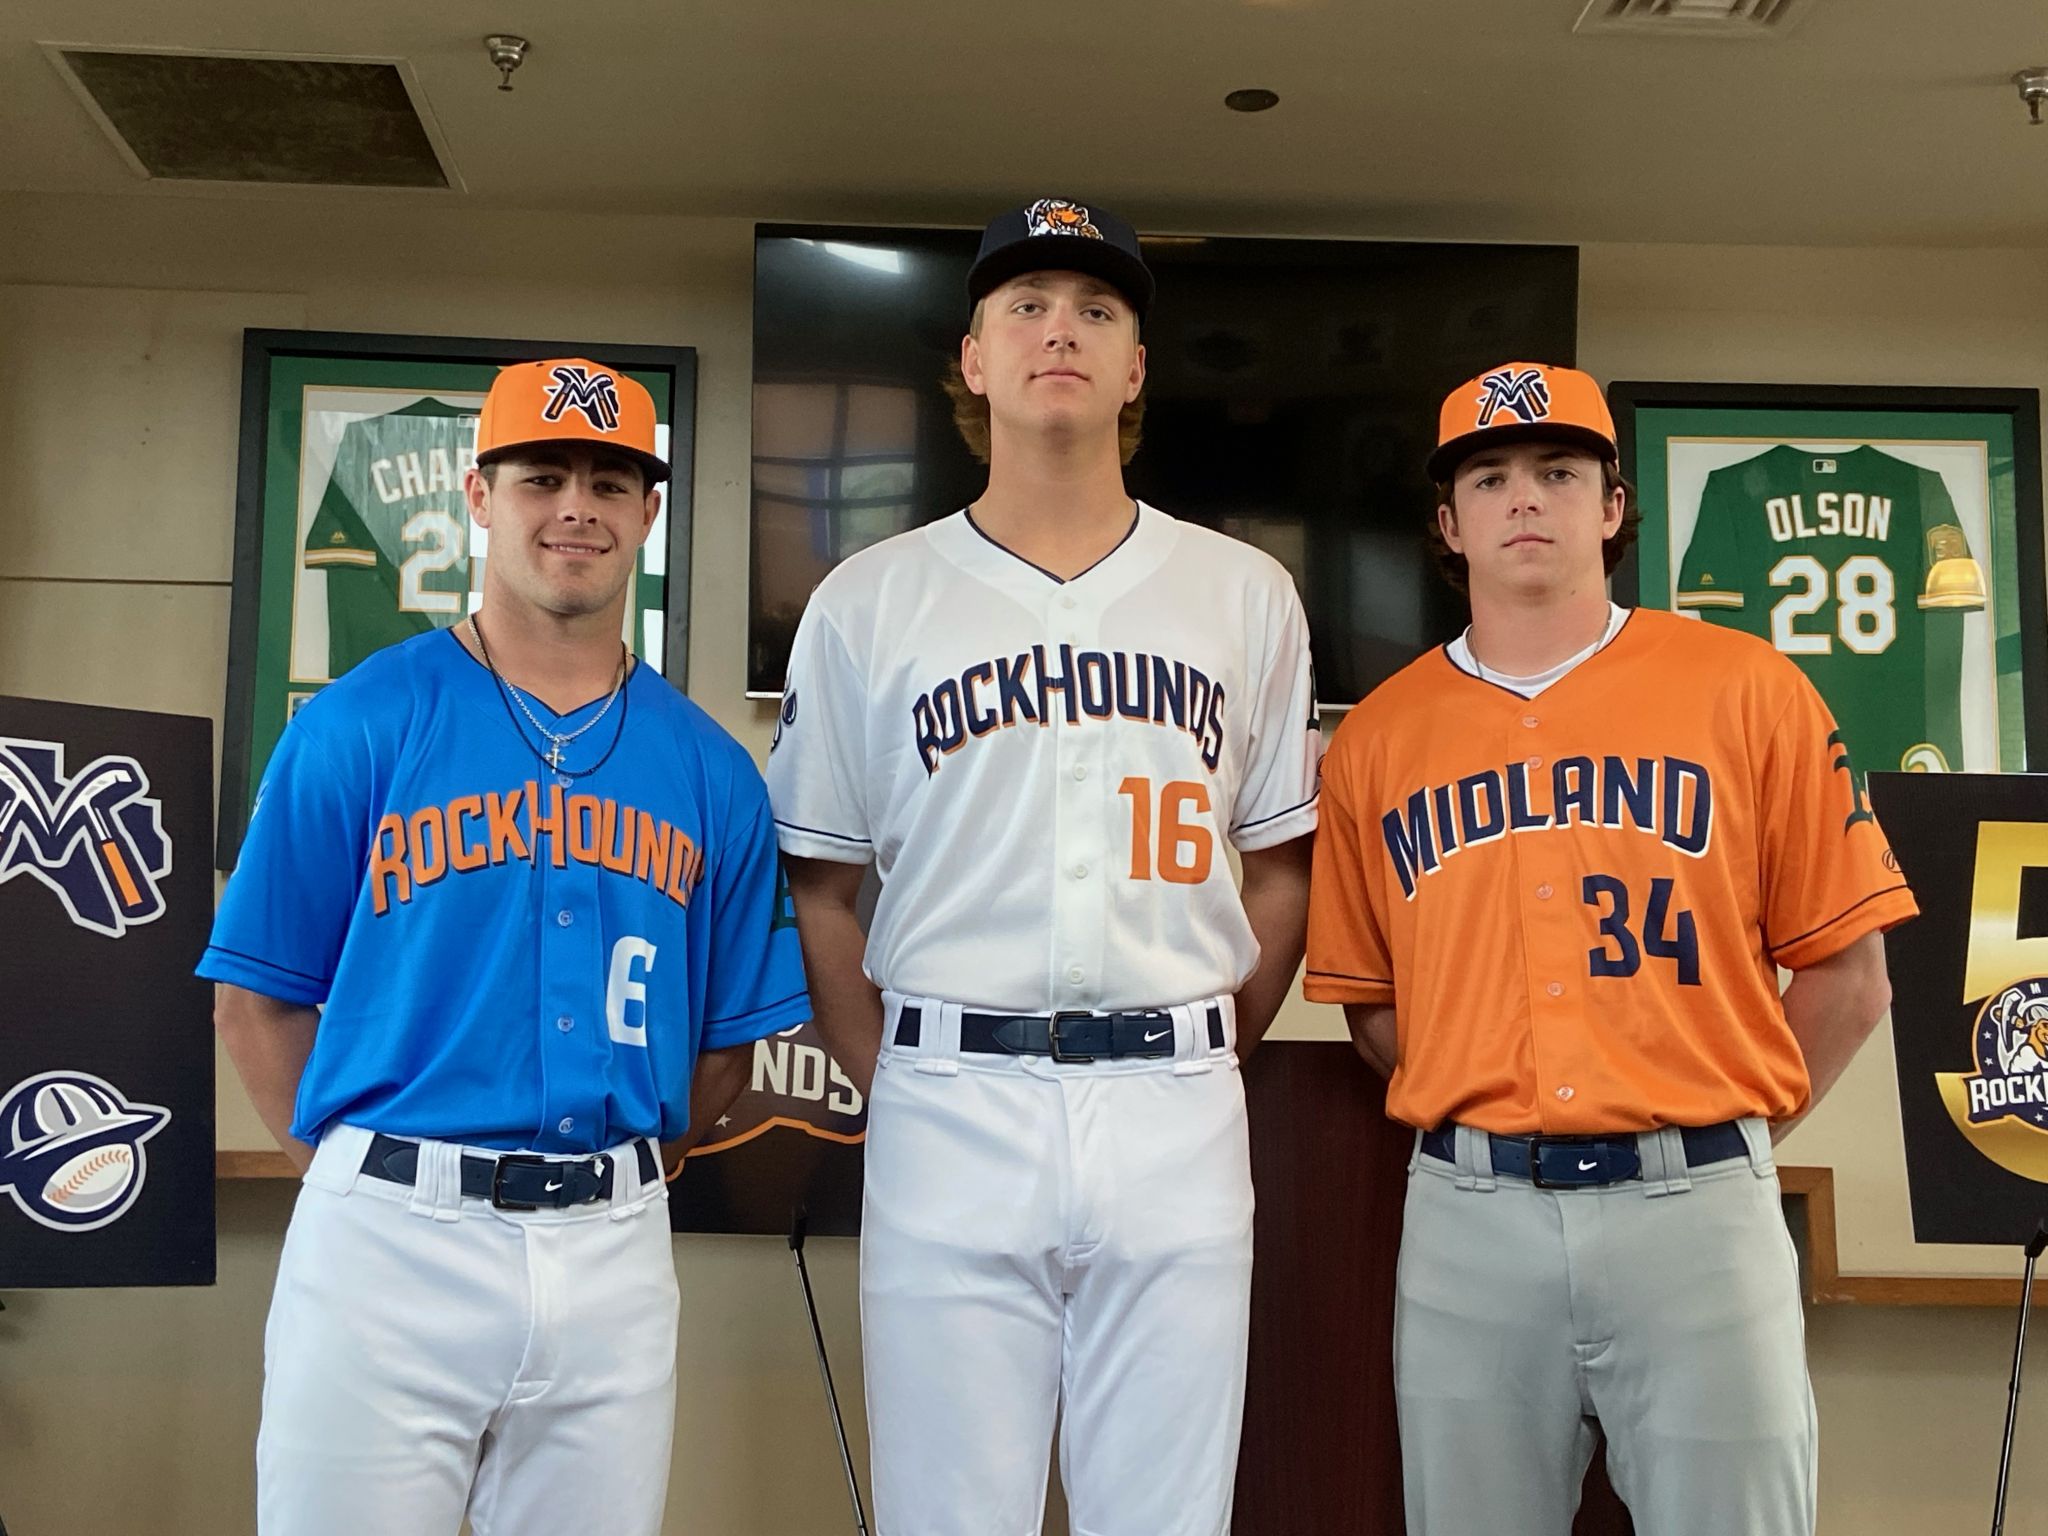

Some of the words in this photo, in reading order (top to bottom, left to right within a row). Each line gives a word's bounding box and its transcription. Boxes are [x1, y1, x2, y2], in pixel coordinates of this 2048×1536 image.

[1765, 492, 1892, 542] OLSON
[1768, 555, 1897, 655] 28
[912, 643, 1225, 779] ROCKHOUNDS
[1117, 776, 1214, 885] 16
[1382, 755, 1713, 902] MIDLAND
[1582, 874, 1702, 987] 34
[605, 935, 657, 1048] 6
[1969, 1072, 2048, 1114] ROCK
